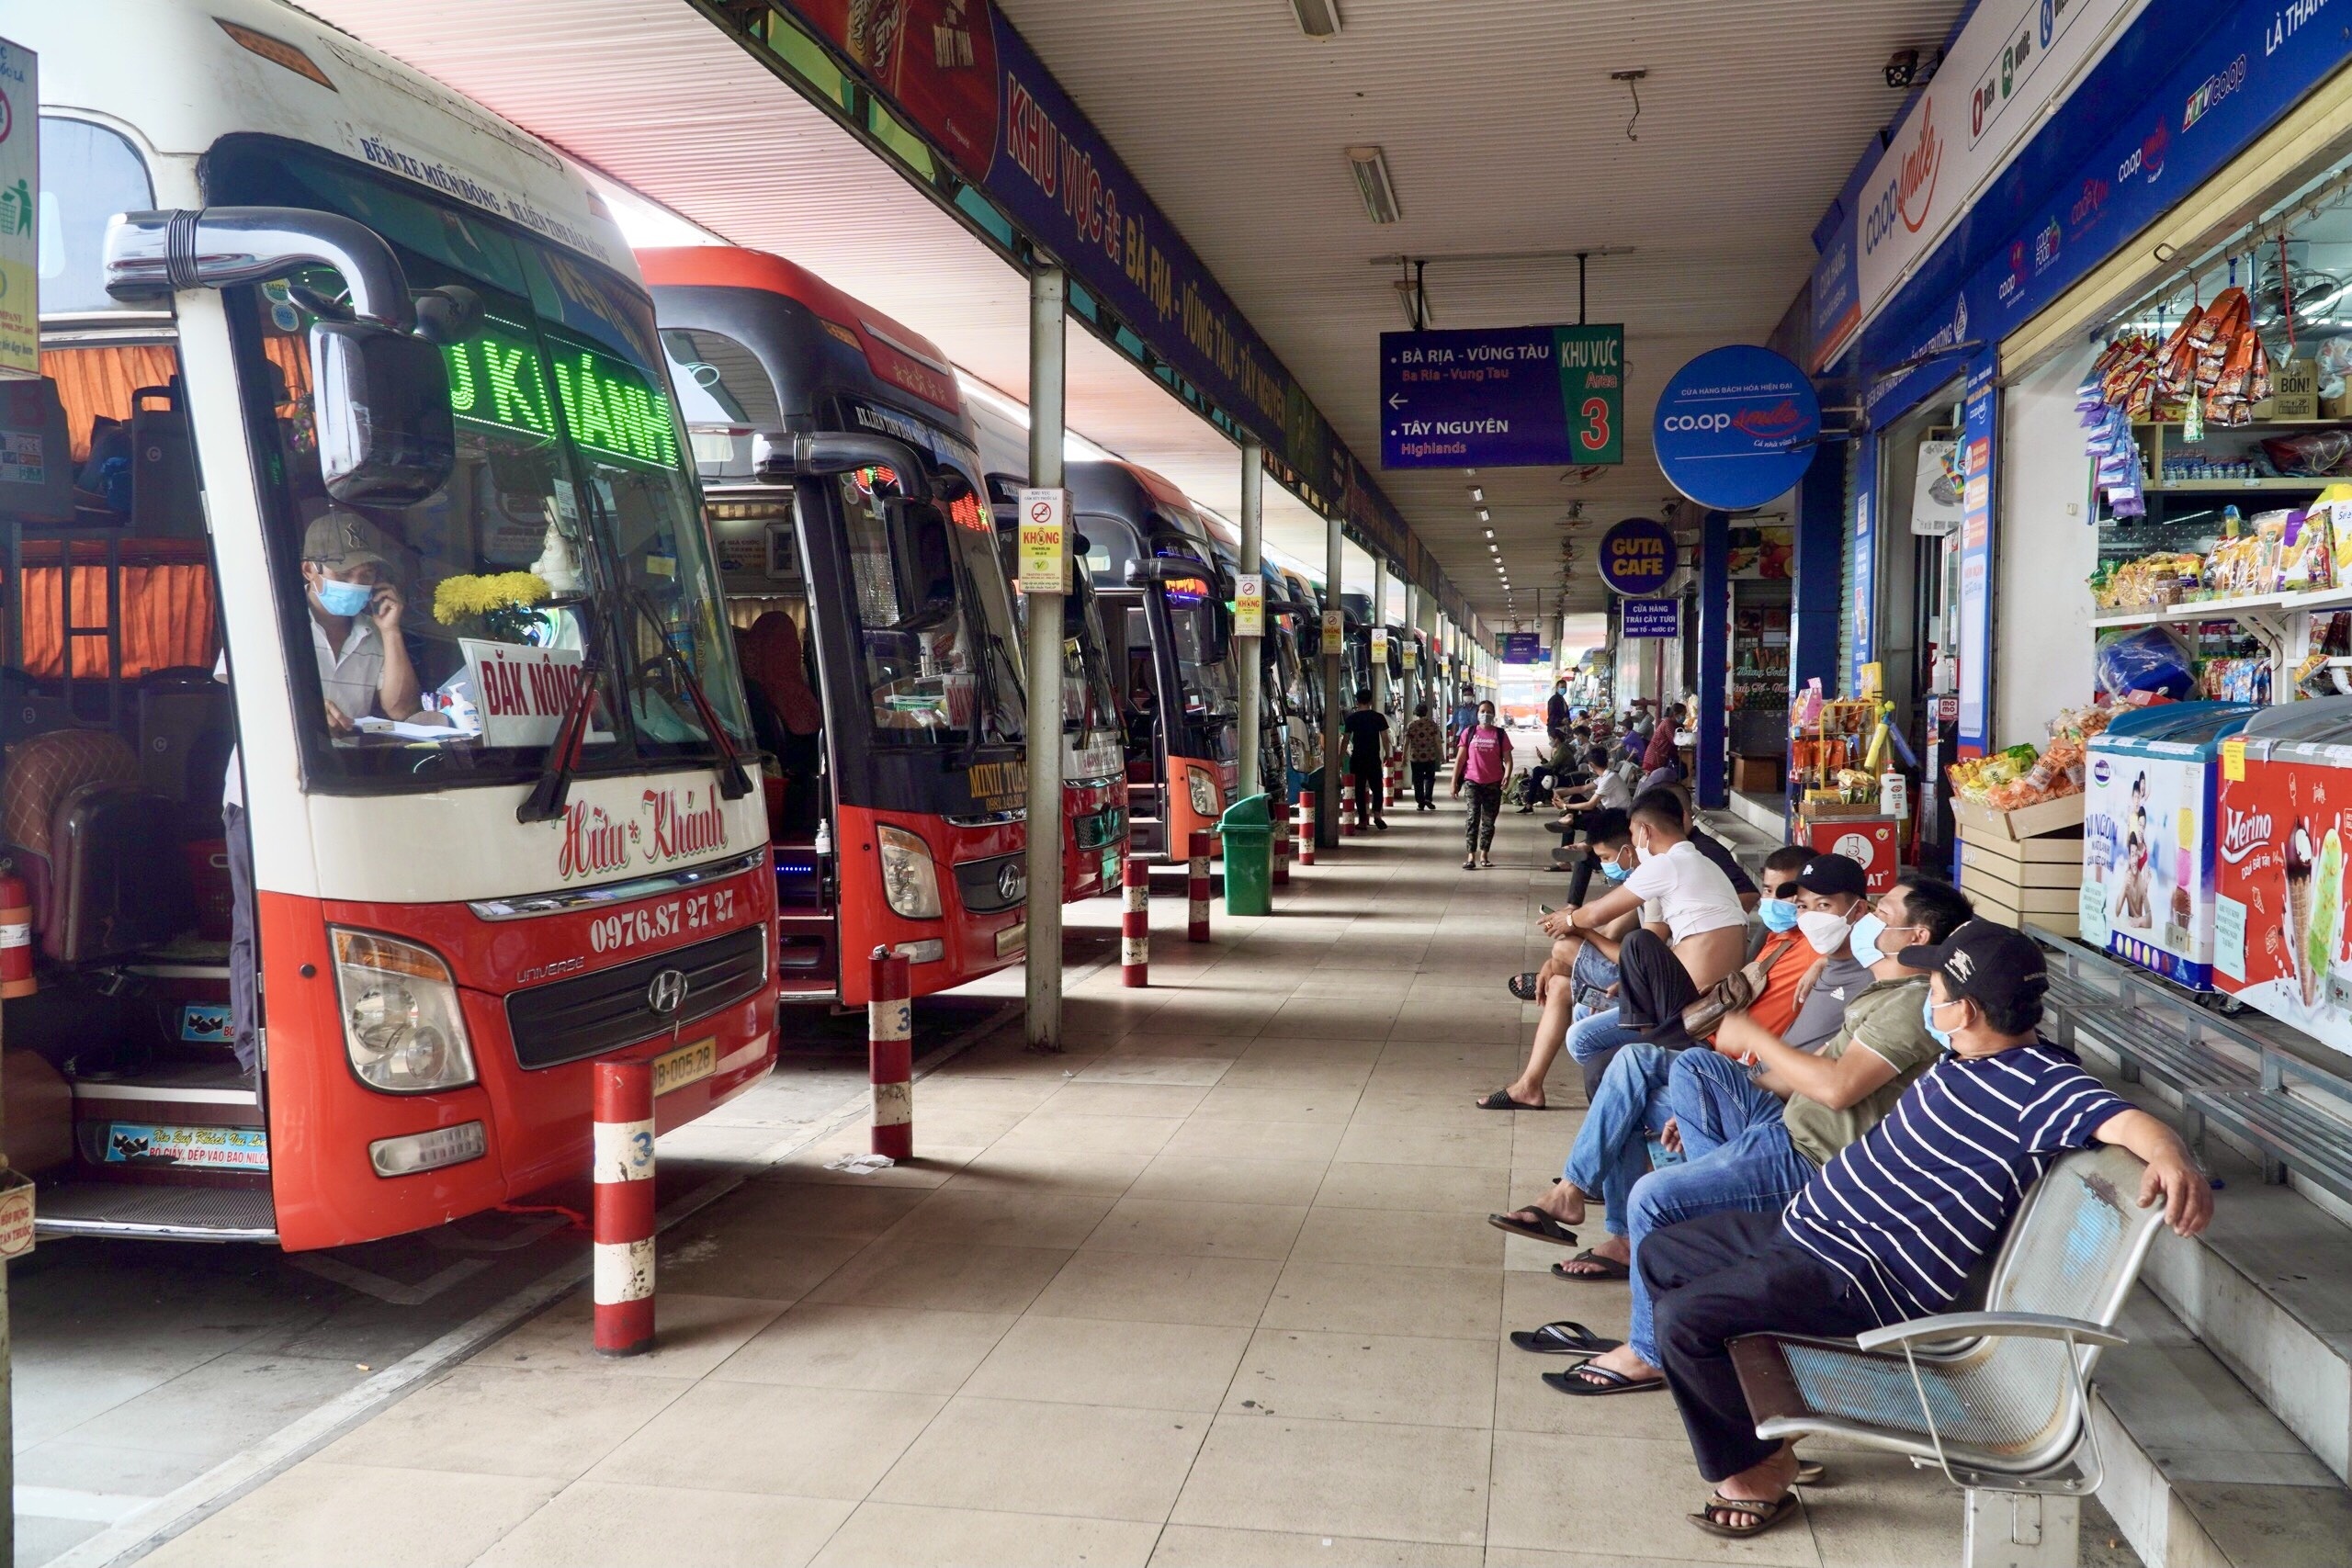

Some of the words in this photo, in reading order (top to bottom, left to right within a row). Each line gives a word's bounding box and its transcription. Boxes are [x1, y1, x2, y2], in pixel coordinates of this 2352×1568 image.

[2266, 11, 2283, 57] LÀ
[360, 138, 398, 169] BẾN
[398, 152, 424, 180] XE
[422, 164, 460, 196] MIỀN
[1008, 70, 1057, 197] KHU
[1060, 130, 1103, 243] VỰC
[1125, 213, 1147, 293] BÀ
[1150, 244, 1172, 323] RỊA
[1182, 279, 1215, 355] VŨNG
[1402, 347, 1424, 364] BÀ
[1428, 347, 1454, 366] RỊA
[1466, 344, 1514, 361] VŨNG
[1518, 344, 1550, 359] TÀU
[1562, 341, 1589, 367] KHU
[1591, 336, 1618, 372] VỰC
[1402, 370, 1418, 382] Ba
[1420, 369, 1441, 381] Ria
[1451, 368, 1484, 382] Vung
[1487, 367, 1509, 379] Tau
[1586, 372, 1618, 389] Area
[1681, 386, 1698, 397] CỬA
[1699, 385, 1720, 395] HÀNG
[1721, 384, 1742, 394] BÁCH
[1743, 384, 1759, 393] HÓA
[1760, 382, 1779, 391] HIỆN
[1780, 381, 1793, 391] ĐẠI
[2281, 378, 2311, 393] BON!
[1401, 420, 1432, 436] TÂY
[1436, 418, 1509, 434] NGUYÊN
[1580, 397, 1610, 450] 3
[1664, 413, 1731, 433] co.op
[1401, 441, 1467, 457] Highlands
[1023, 527, 1059, 546] KHÔNG
[1611, 537, 1665, 556] GUTA
[1612, 558, 1664, 576] CAFE
[1633, 604, 1647, 613] CỬA
[1648, 604, 1668, 613] HÀNG
[481, 649, 530, 716] ĐĂK
[642, 783, 729, 862] Khánh
[2224, 805, 2271, 851] Merino
[591, 901, 680, 953] 0976.87
[687, 896, 708, 928] 27
[714, 889, 734, 921] 27
[516, 956, 584, 983] UNIVERSE
[208, 1148, 224, 1162] VÀO
[227, 1151, 243, 1163] BAO
[632, 1132, 654, 1167] 3
